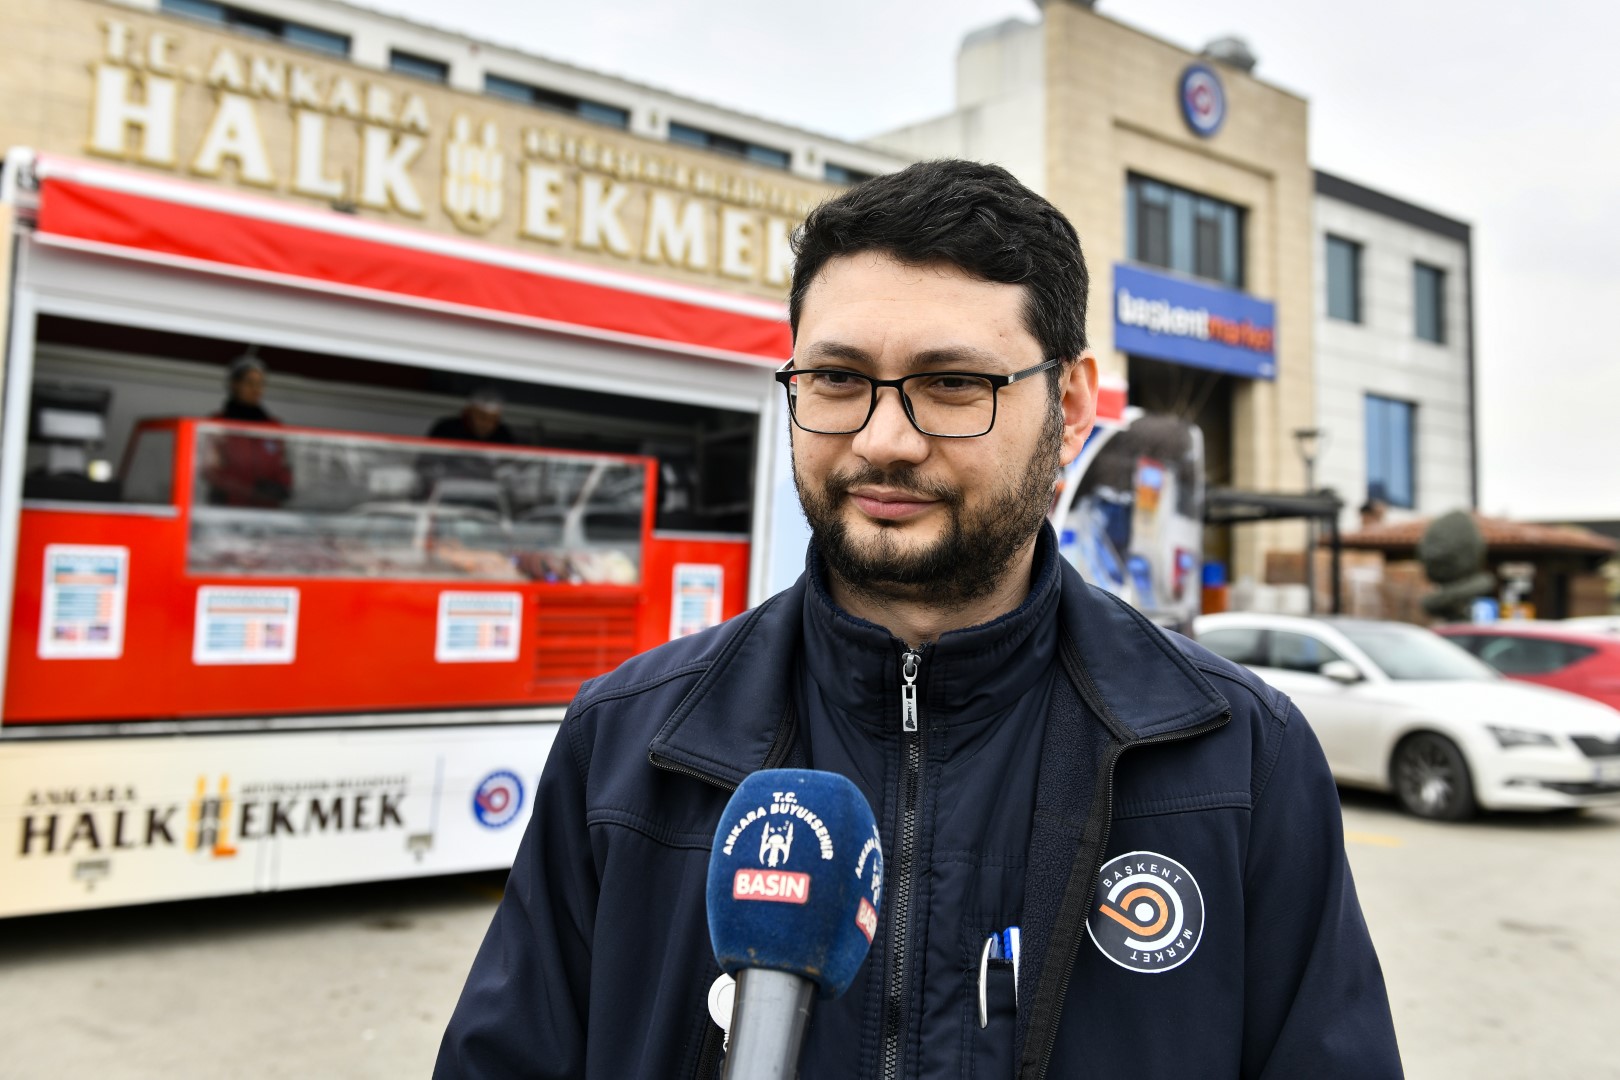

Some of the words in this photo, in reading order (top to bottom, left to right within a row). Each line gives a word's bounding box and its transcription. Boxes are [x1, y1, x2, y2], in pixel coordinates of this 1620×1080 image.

[206, 47, 430, 136] ANKARA
[84, 62, 424, 218] HALK
[772, 791, 798, 804] T.C.
[21, 802, 178, 857] HALK
[239, 794, 407, 838] EKMEK
[722, 806, 767, 856] ANKARA
[736, 873, 806, 899] BASIN
[1129, 928, 1193, 963] MARKET
